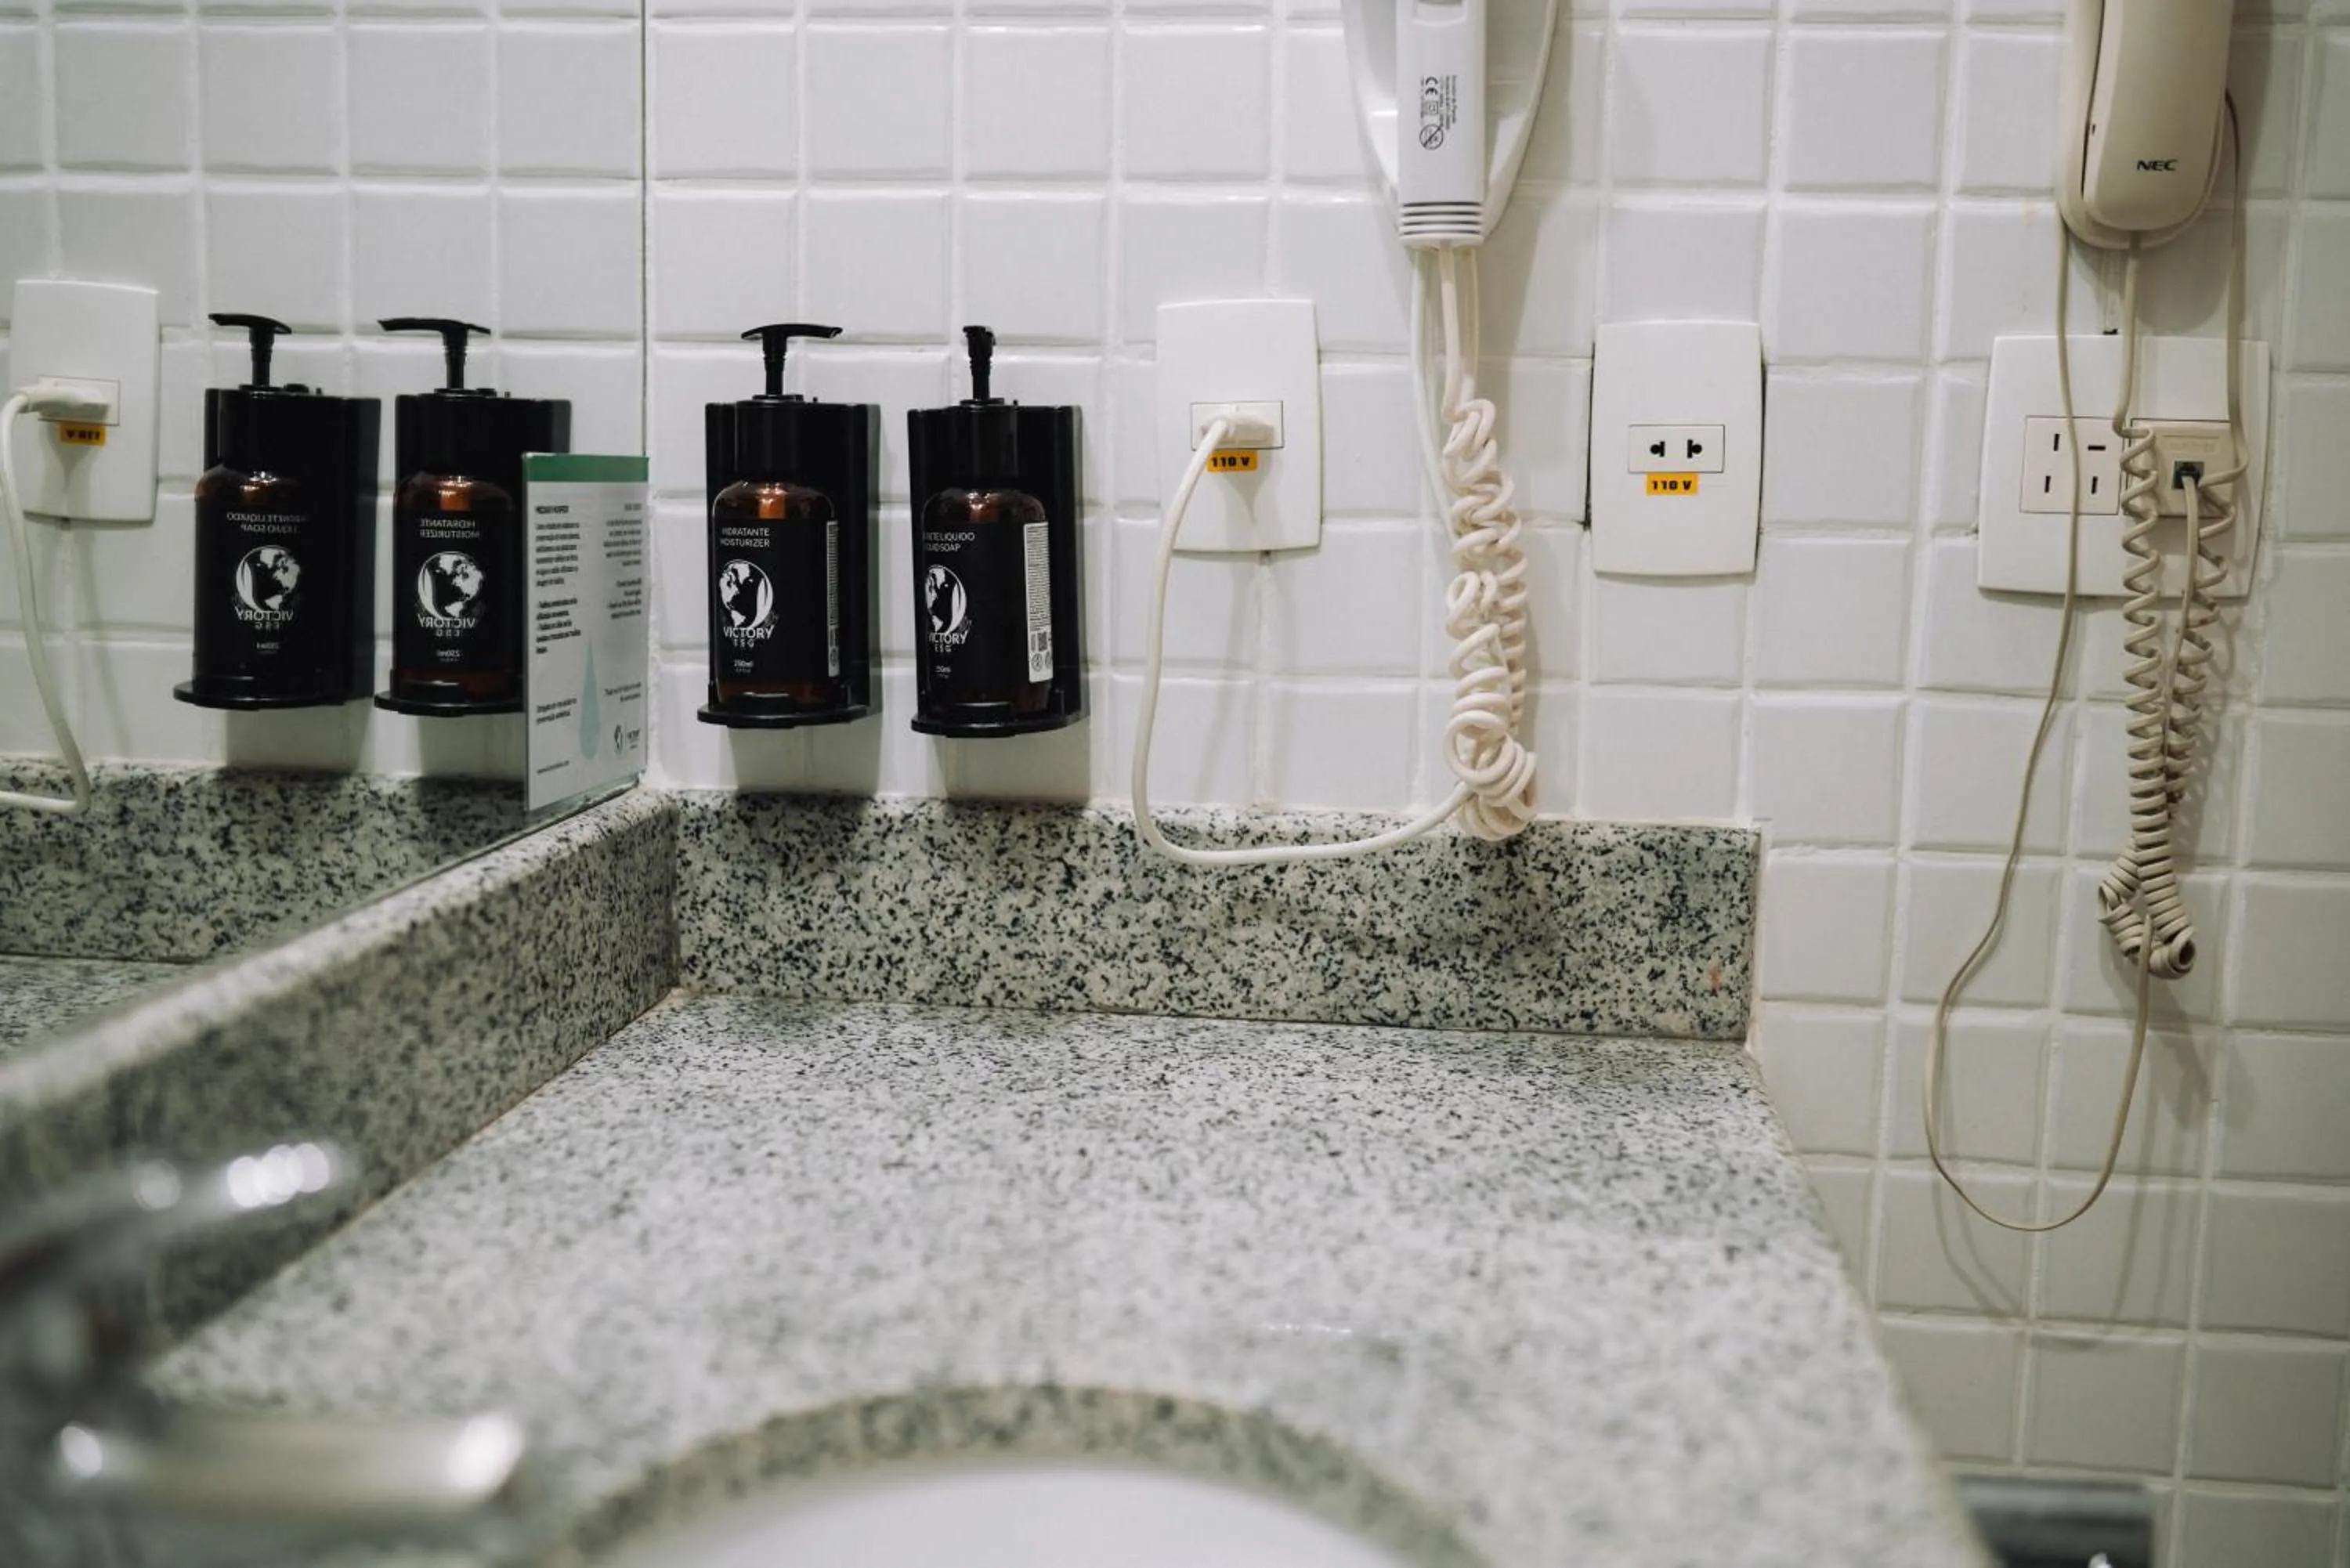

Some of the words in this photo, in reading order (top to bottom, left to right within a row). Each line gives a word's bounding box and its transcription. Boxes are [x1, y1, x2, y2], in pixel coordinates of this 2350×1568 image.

[2136, 159, 2178, 171] NEC
[1212, 457, 1237, 468] 110
[1241, 457, 1250, 467] V
[1652, 479, 1678, 490] 110
[1682, 479, 1692, 490] V
[723, 625, 775, 639] VICTORY
